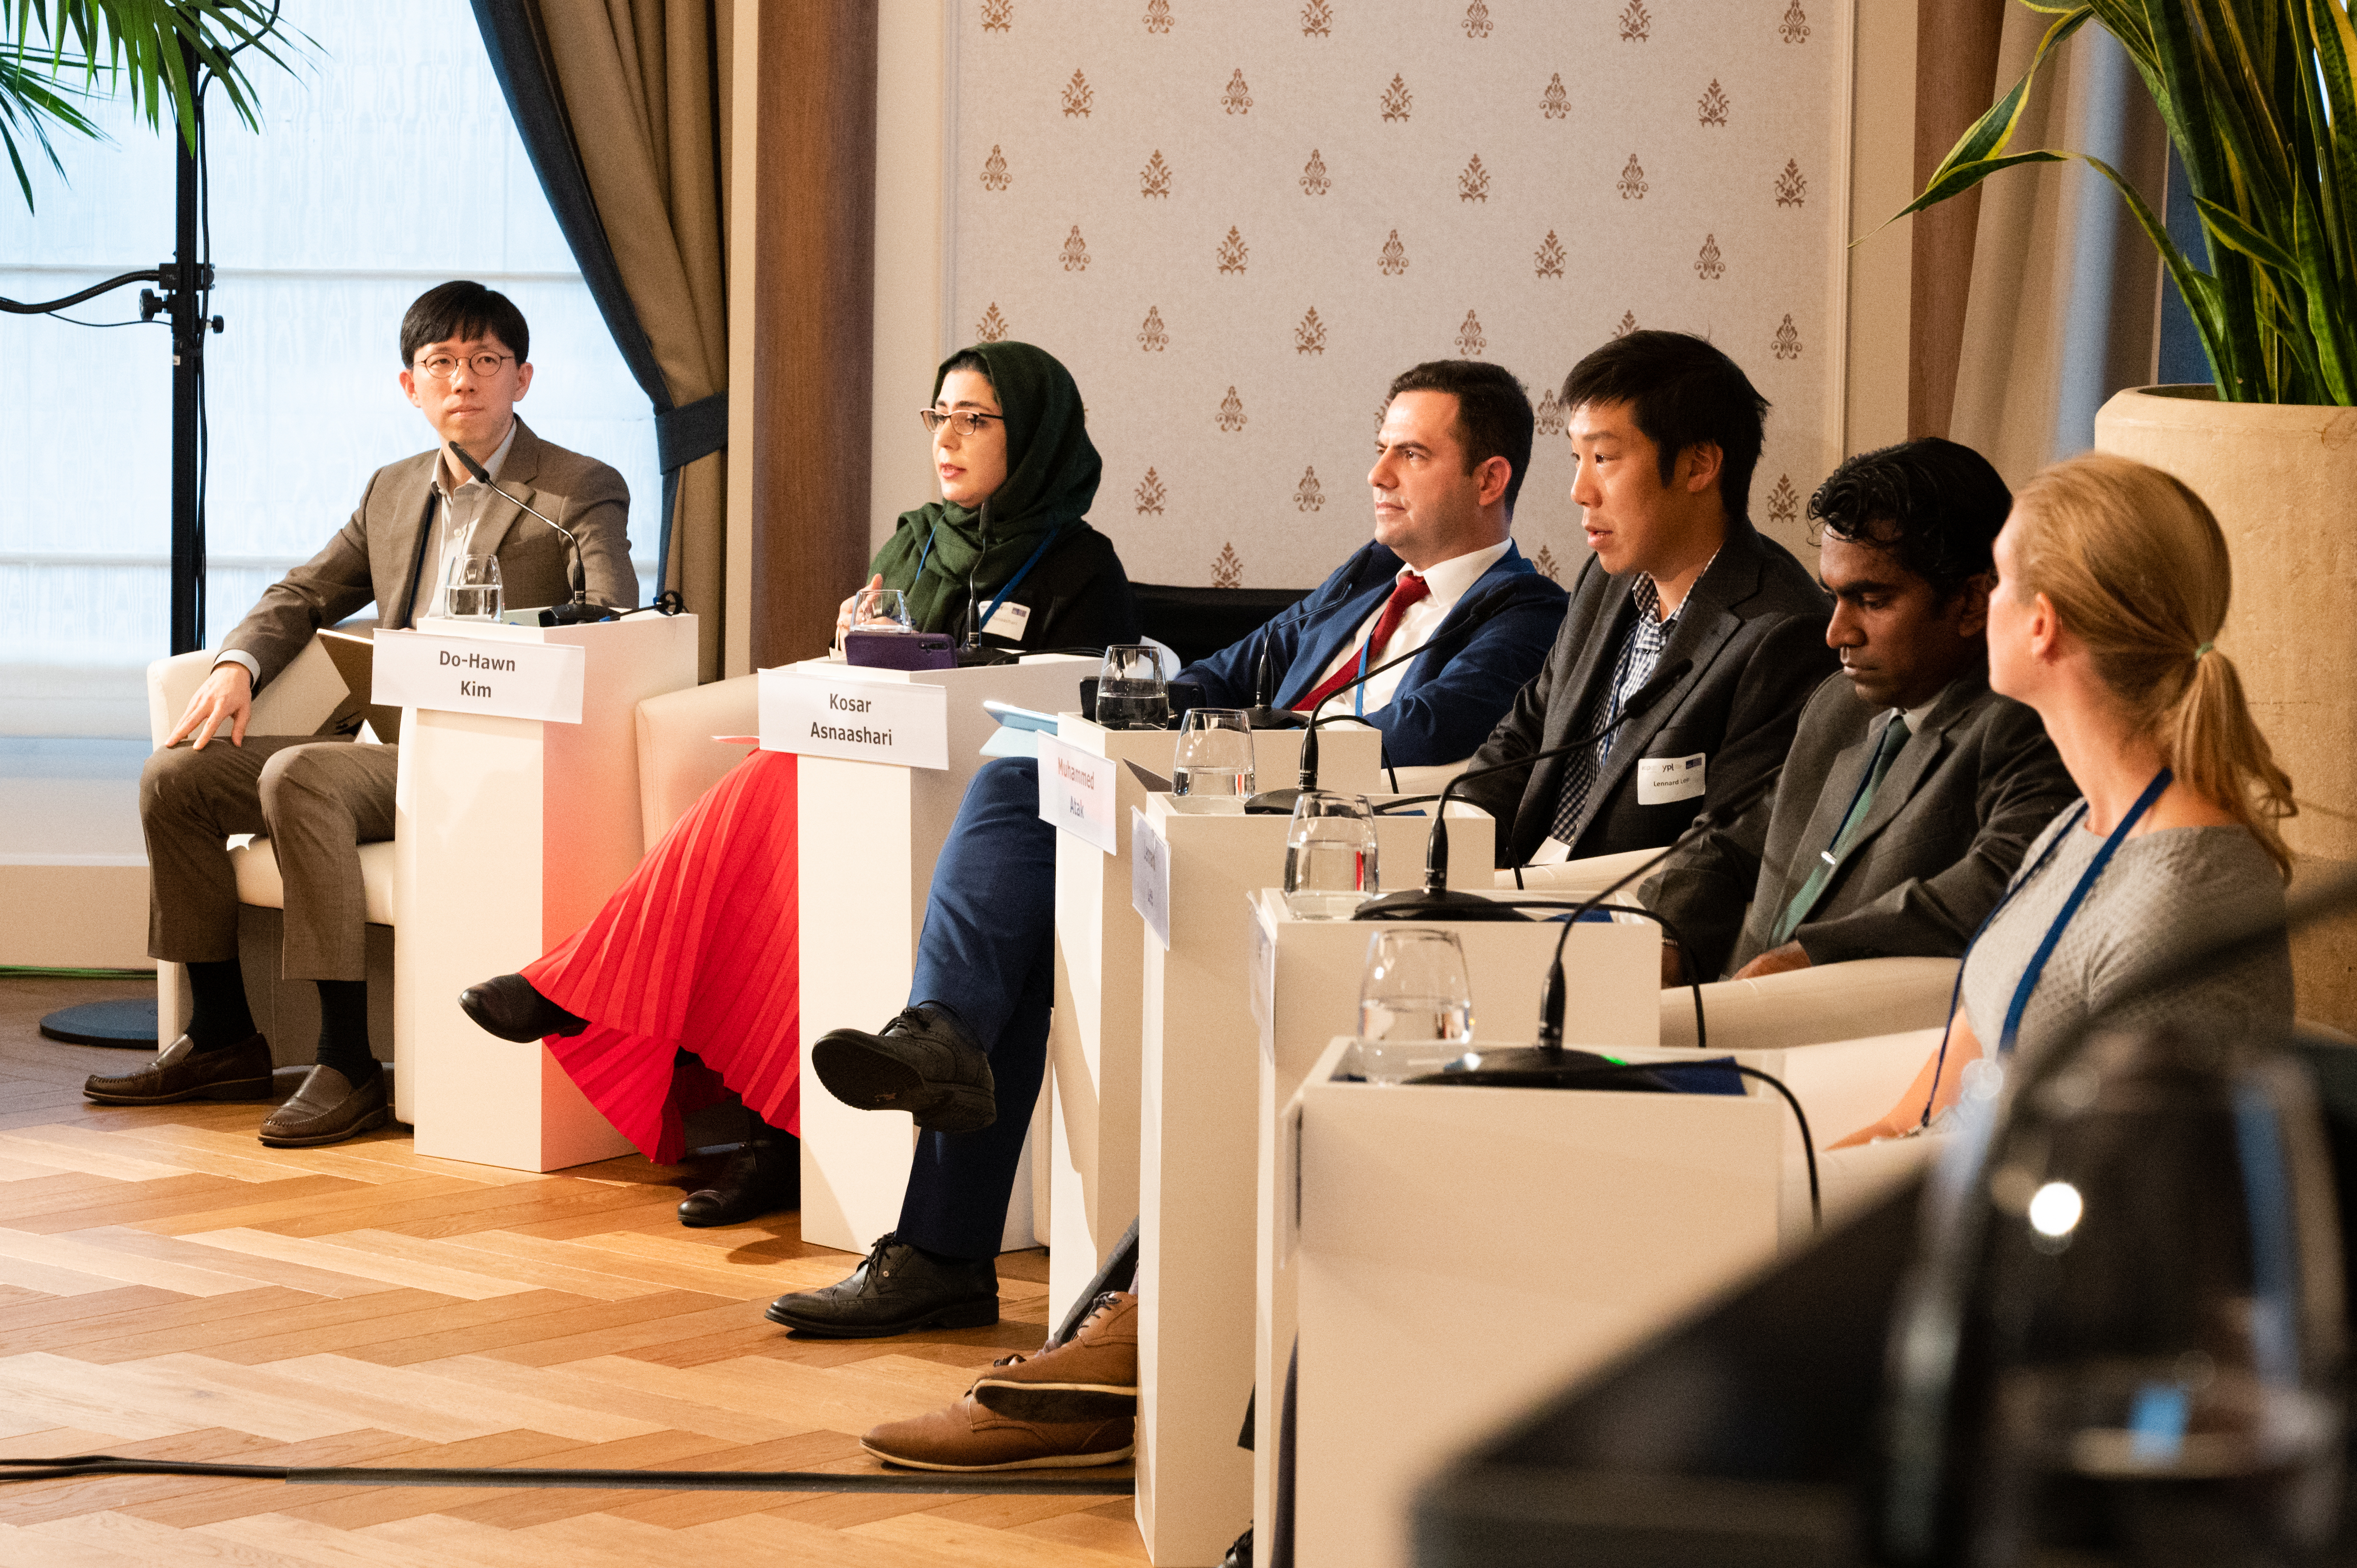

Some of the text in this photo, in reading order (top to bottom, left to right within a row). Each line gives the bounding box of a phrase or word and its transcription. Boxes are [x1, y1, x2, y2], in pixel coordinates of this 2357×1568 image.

[440, 651, 516, 672] Do-Hawn
[461, 680, 491, 698] Kim
[830, 693, 871, 713] Kosar
[811, 722, 892, 746] Asnaashari
[1058, 757, 1094, 790] Muhammed
[1662, 763, 1674, 772] ypl
[1070, 796, 1084, 819] Atak
